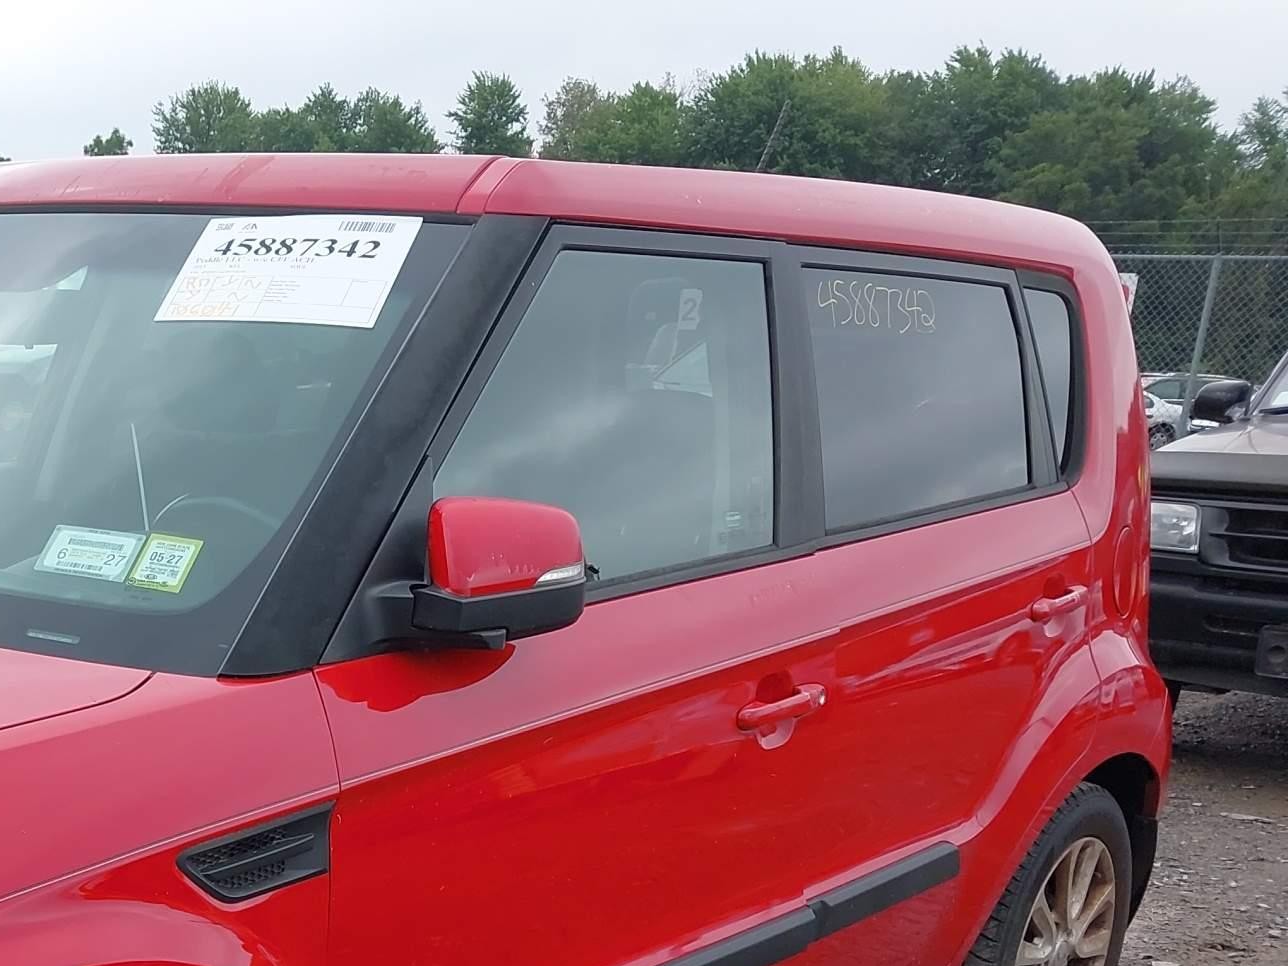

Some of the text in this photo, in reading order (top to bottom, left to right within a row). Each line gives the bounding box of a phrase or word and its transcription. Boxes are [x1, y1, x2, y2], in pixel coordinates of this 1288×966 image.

[214, 237, 381, 259] 45887342
[817, 279, 937, 334] 45887342
[56, 548, 69, 560] 6
[103, 553, 127, 567] 27
